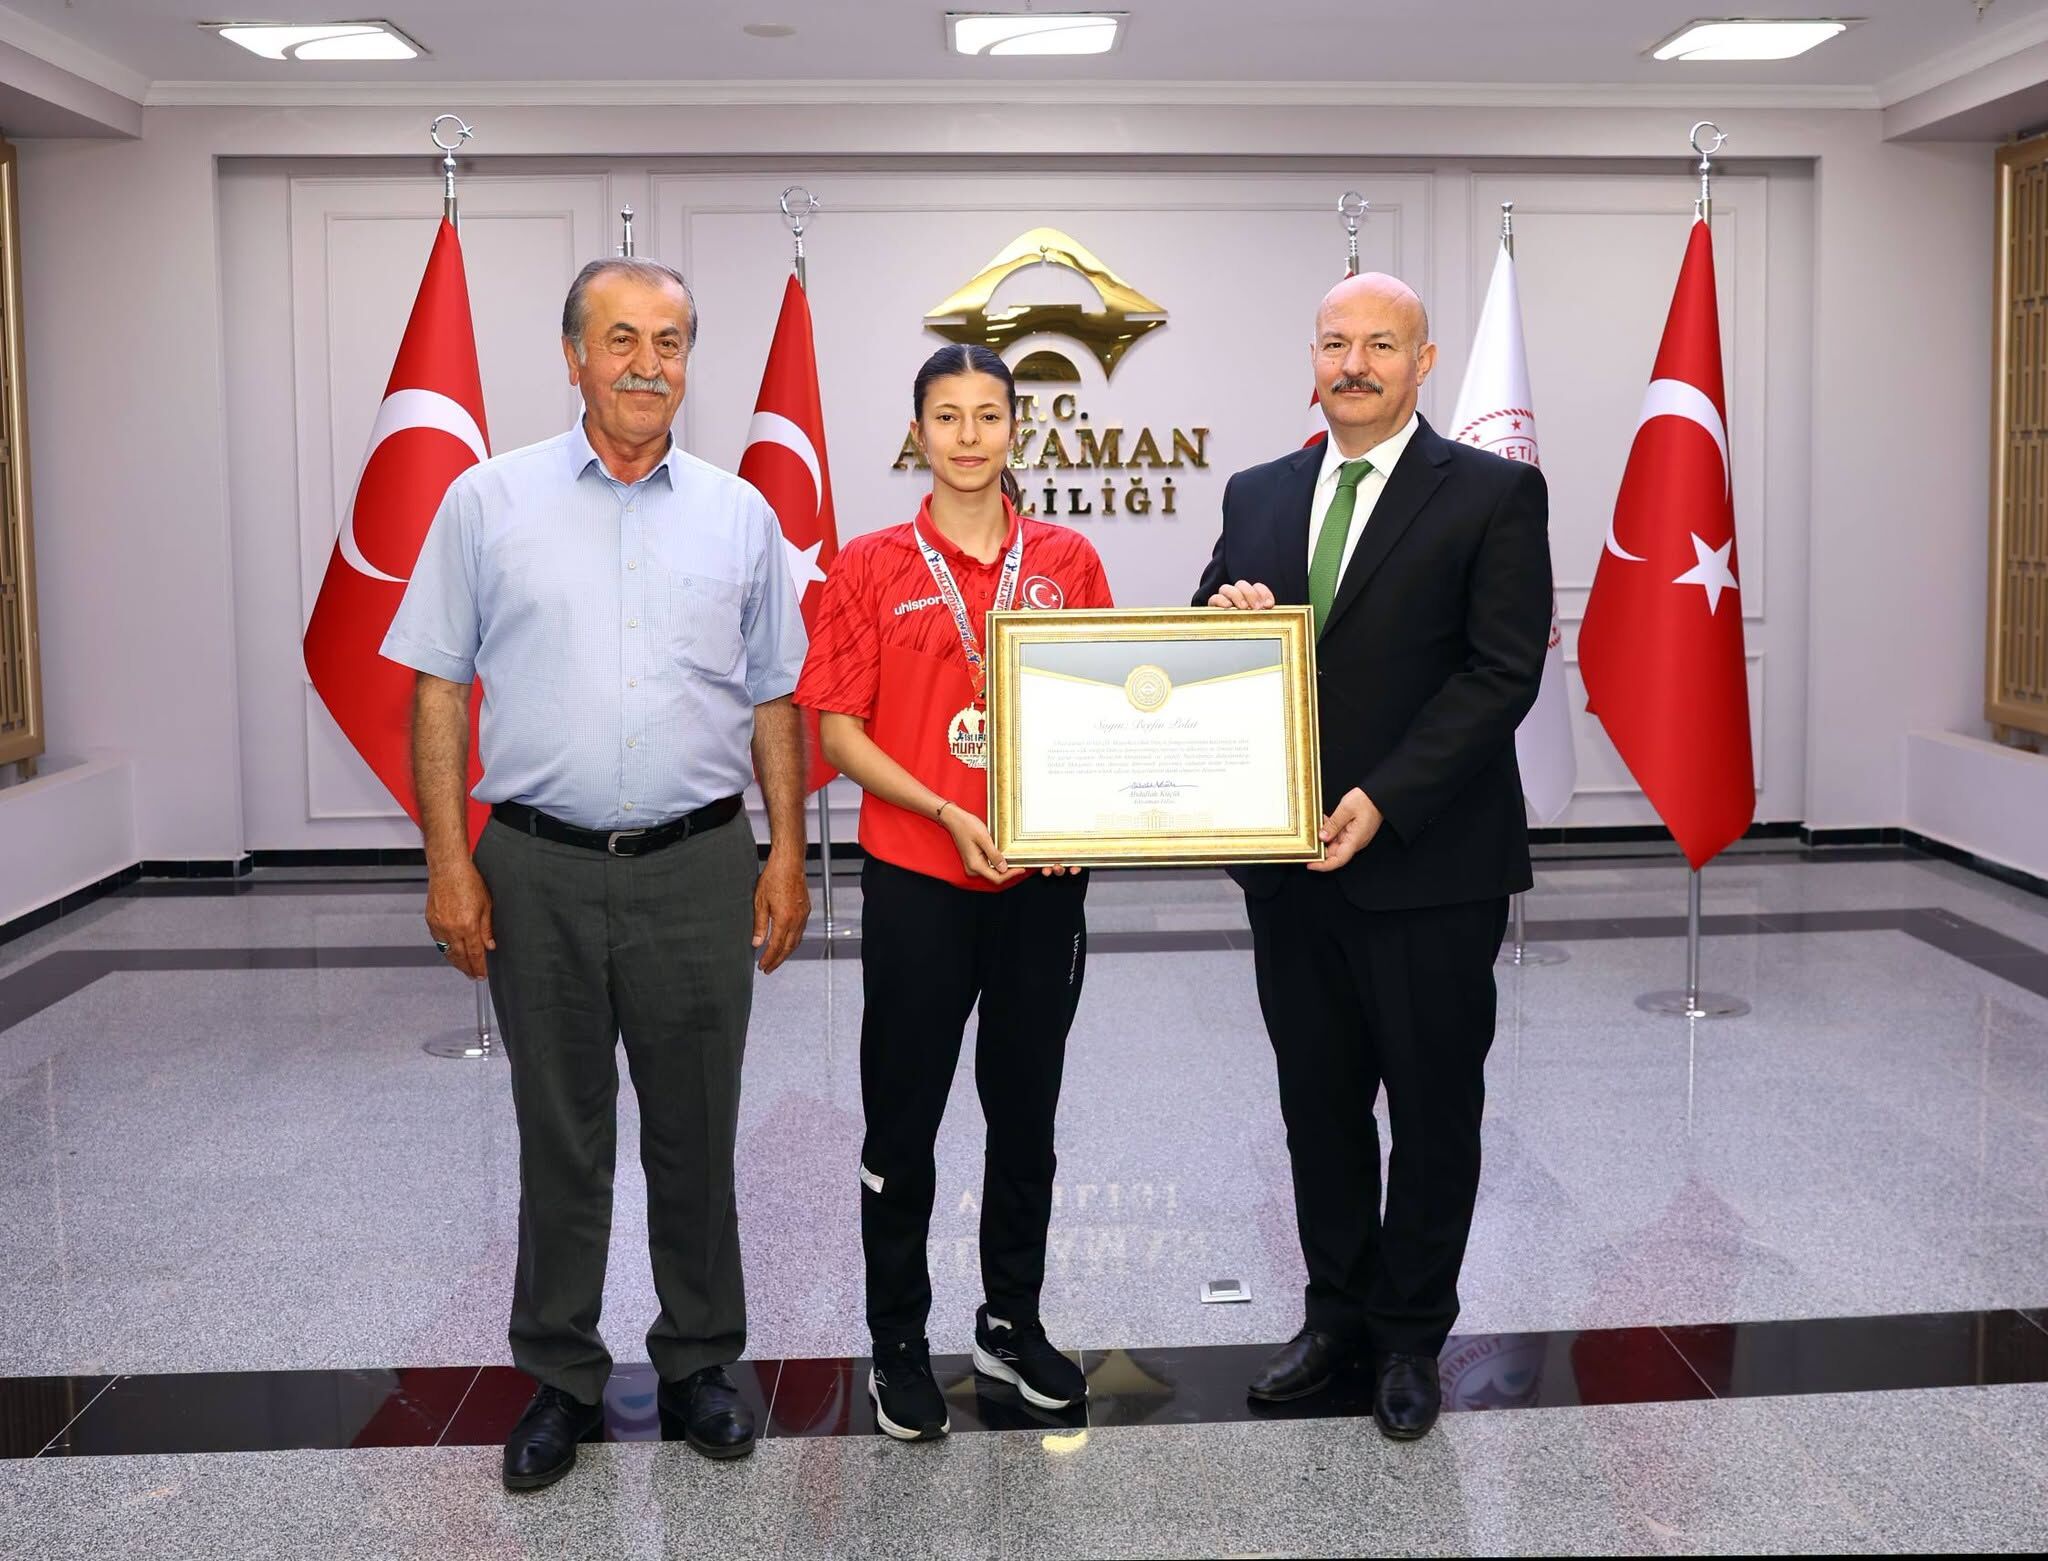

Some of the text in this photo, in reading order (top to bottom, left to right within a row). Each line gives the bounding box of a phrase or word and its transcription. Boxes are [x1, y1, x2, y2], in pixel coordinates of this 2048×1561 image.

[892, 427, 1209, 468] AYAMAN
[1018, 478, 1176, 514] LİLİĞİ
[894, 595, 948, 615] uhlsport
[932, 563, 959, 612] MUAYTHAI
